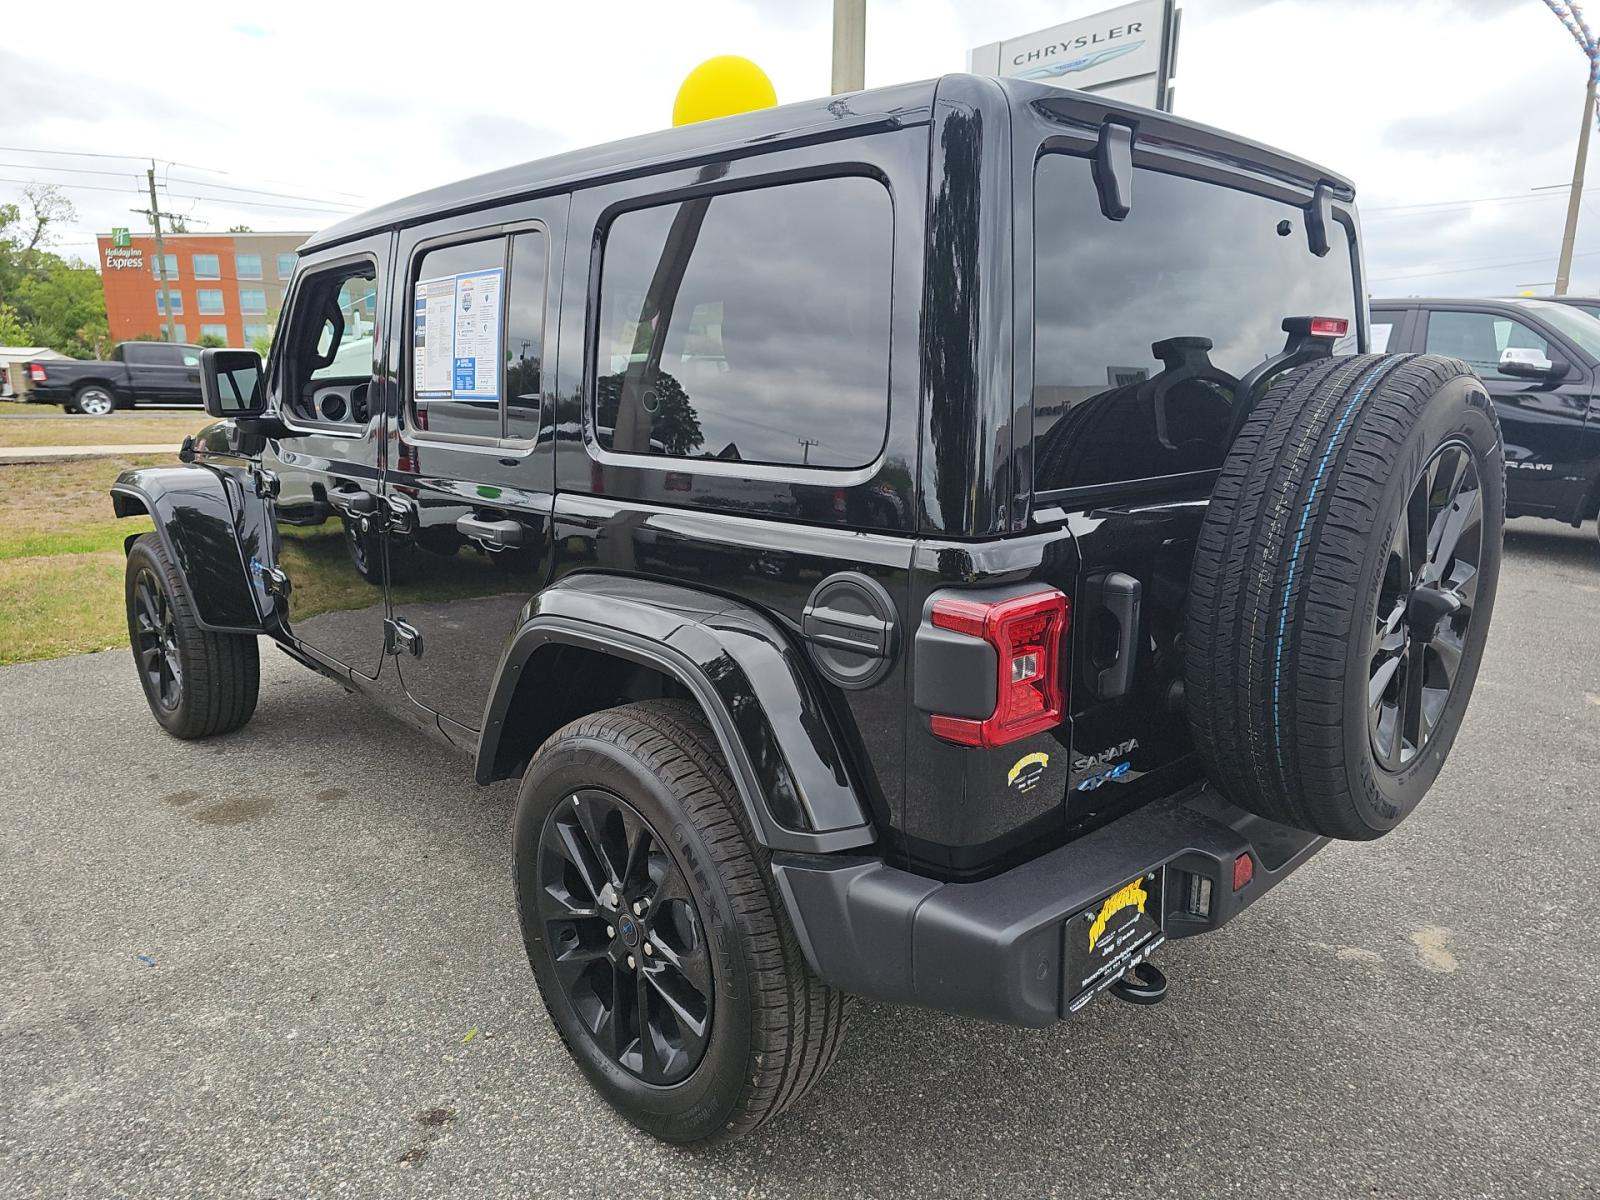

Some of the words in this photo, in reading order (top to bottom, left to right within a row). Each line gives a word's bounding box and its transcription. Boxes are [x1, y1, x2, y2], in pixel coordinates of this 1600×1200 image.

[1013, 22, 1143, 66] CHRYSLER
[106, 256, 143, 270] Express
[1504, 461, 1553, 471] RAM
[1072, 738, 1140, 772] SAHARA
